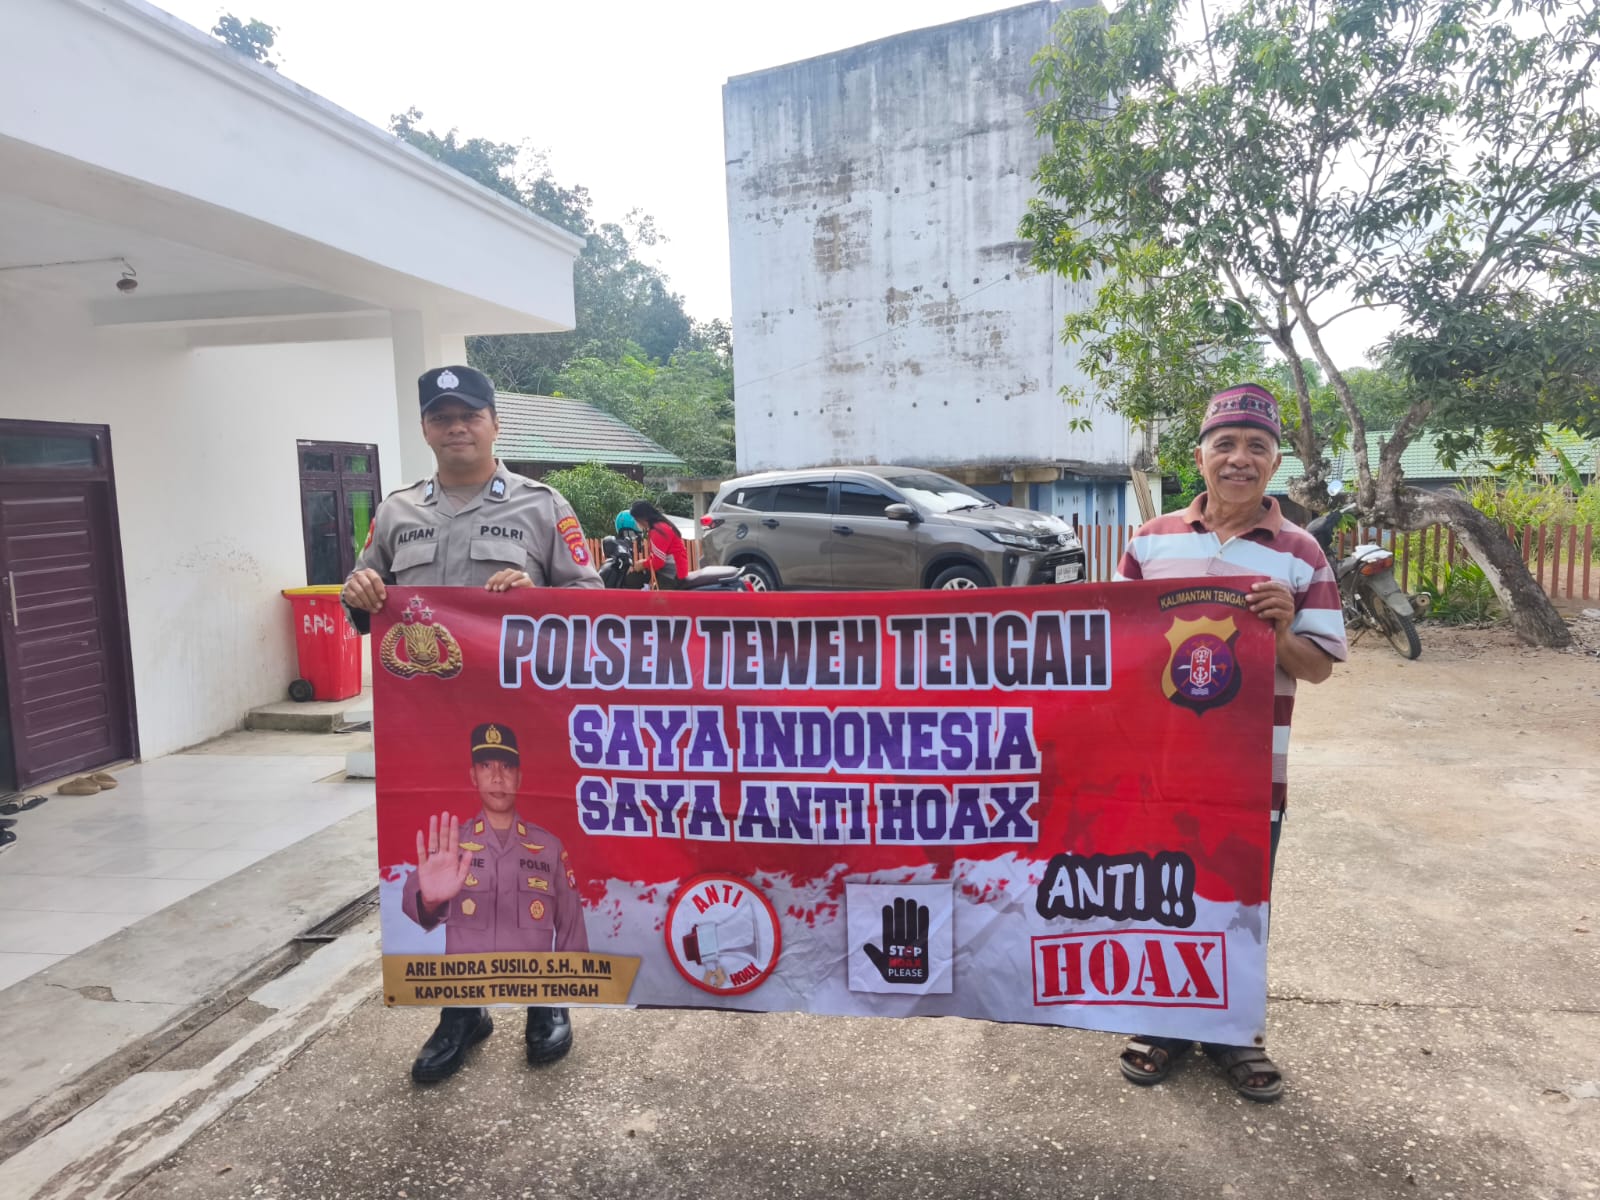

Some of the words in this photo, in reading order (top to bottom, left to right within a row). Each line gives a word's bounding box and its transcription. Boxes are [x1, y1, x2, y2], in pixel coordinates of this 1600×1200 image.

[397, 527, 435, 544] ALFIAN
[480, 525, 523, 540] POLRI
[1160, 590, 1211, 608] KALIMANTAN
[1214, 590, 1246, 607] TENGAH
[501, 615, 691, 689] POLSEK
[697, 617, 880, 689] TEWEH
[888, 611, 1110, 690] TENGAH
[569, 705, 732, 771] SAYA
[737, 706, 1041, 774] INDONESIA
[577, 777, 730, 841] SAYA
[735, 780, 870, 844] ANTI
[875, 782, 1038, 844] HOAX
[520, 859, 551, 873] POLRI
[1046, 861, 1146, 912] ANTI
[691, 883, 744, 915] ANTI
[889, 945, 922, 957] STOP
[405, 962, 437, 977] ARIE
[441, 960, 487, 976] INDRA
[491, 959, 543, 975] SUSILO,
[582, 959, 611, 974] M.M
[729, 961, 762, 987] HOAX
[888, 968, 923, 977] PLEASE
[1039, 939, 1220, 999] HOAX
[415, 985, 486, 999] KAPOLSEK
[489, 984, 538, 998] TEWEH
[541, 984, 599, 998] TENGAH
